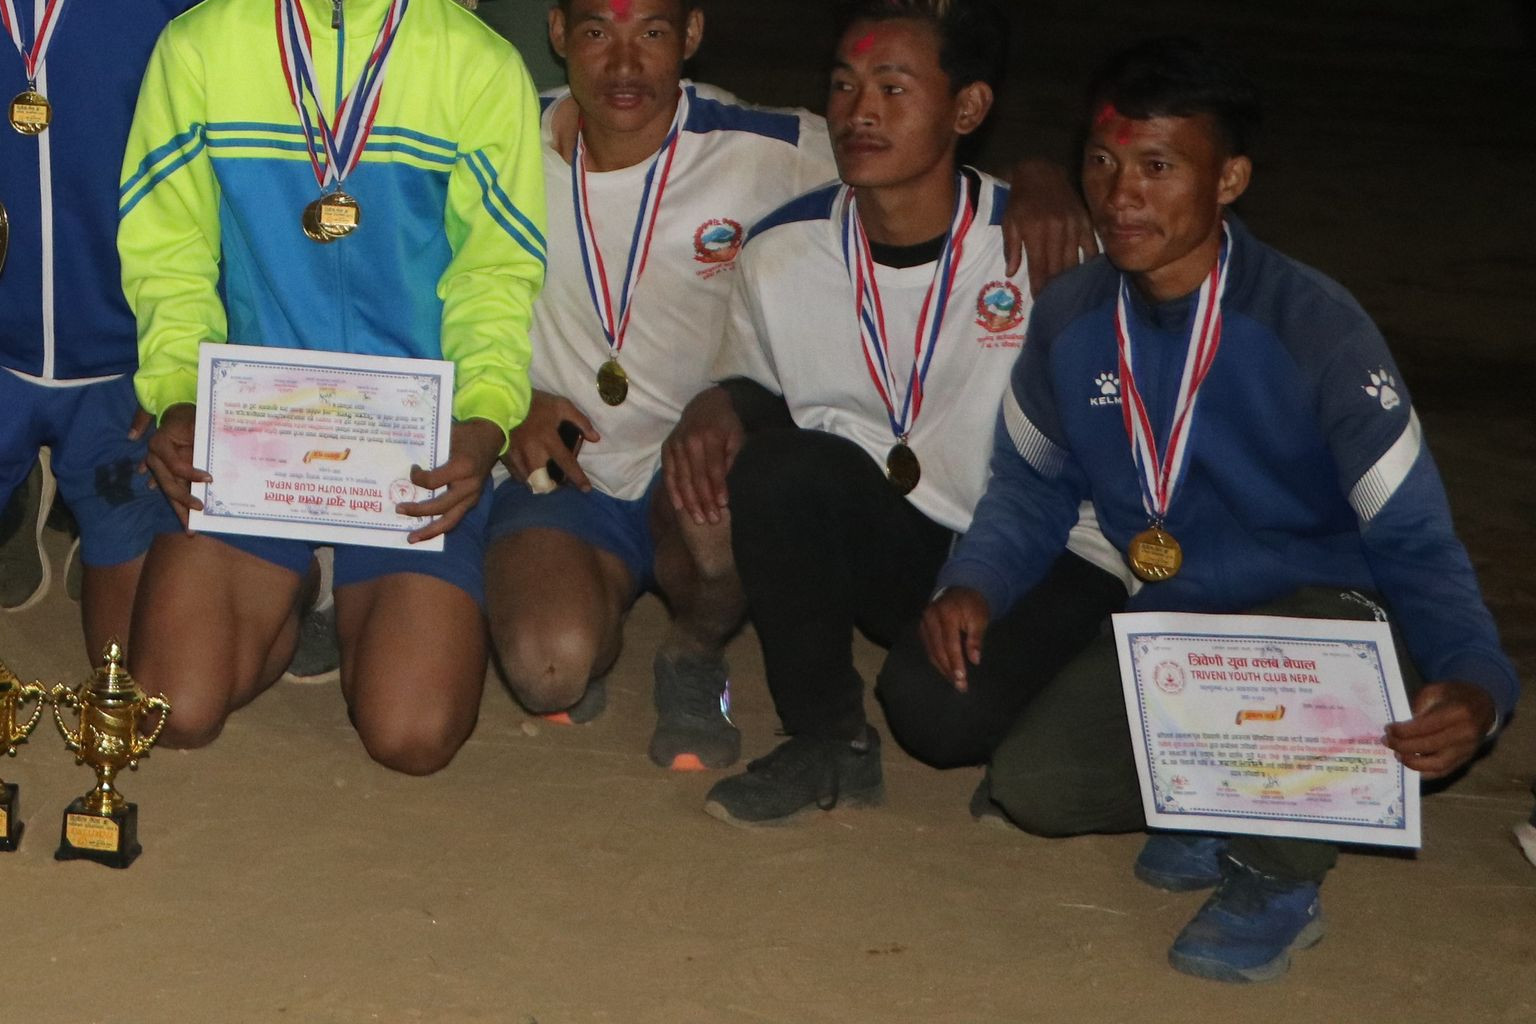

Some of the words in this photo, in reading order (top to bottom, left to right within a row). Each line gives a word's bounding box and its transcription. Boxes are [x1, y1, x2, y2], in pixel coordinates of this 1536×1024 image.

[1089, 396, 1123, 406] KELM
[265, 479, 292, 490] NEPAL
[294, 482, 316, 492] CLUB
[318, 484, 349, 495] YOUTH
[350, 487, 383, 497] TRIVENI
[1191, 670, 1227, 681] TRIVENI
[1227, 671, 1261, 682] YOUTH
[1263, 672, 1288, 683] CLUB
[1290, 673, 1320, 684] NEPAL
